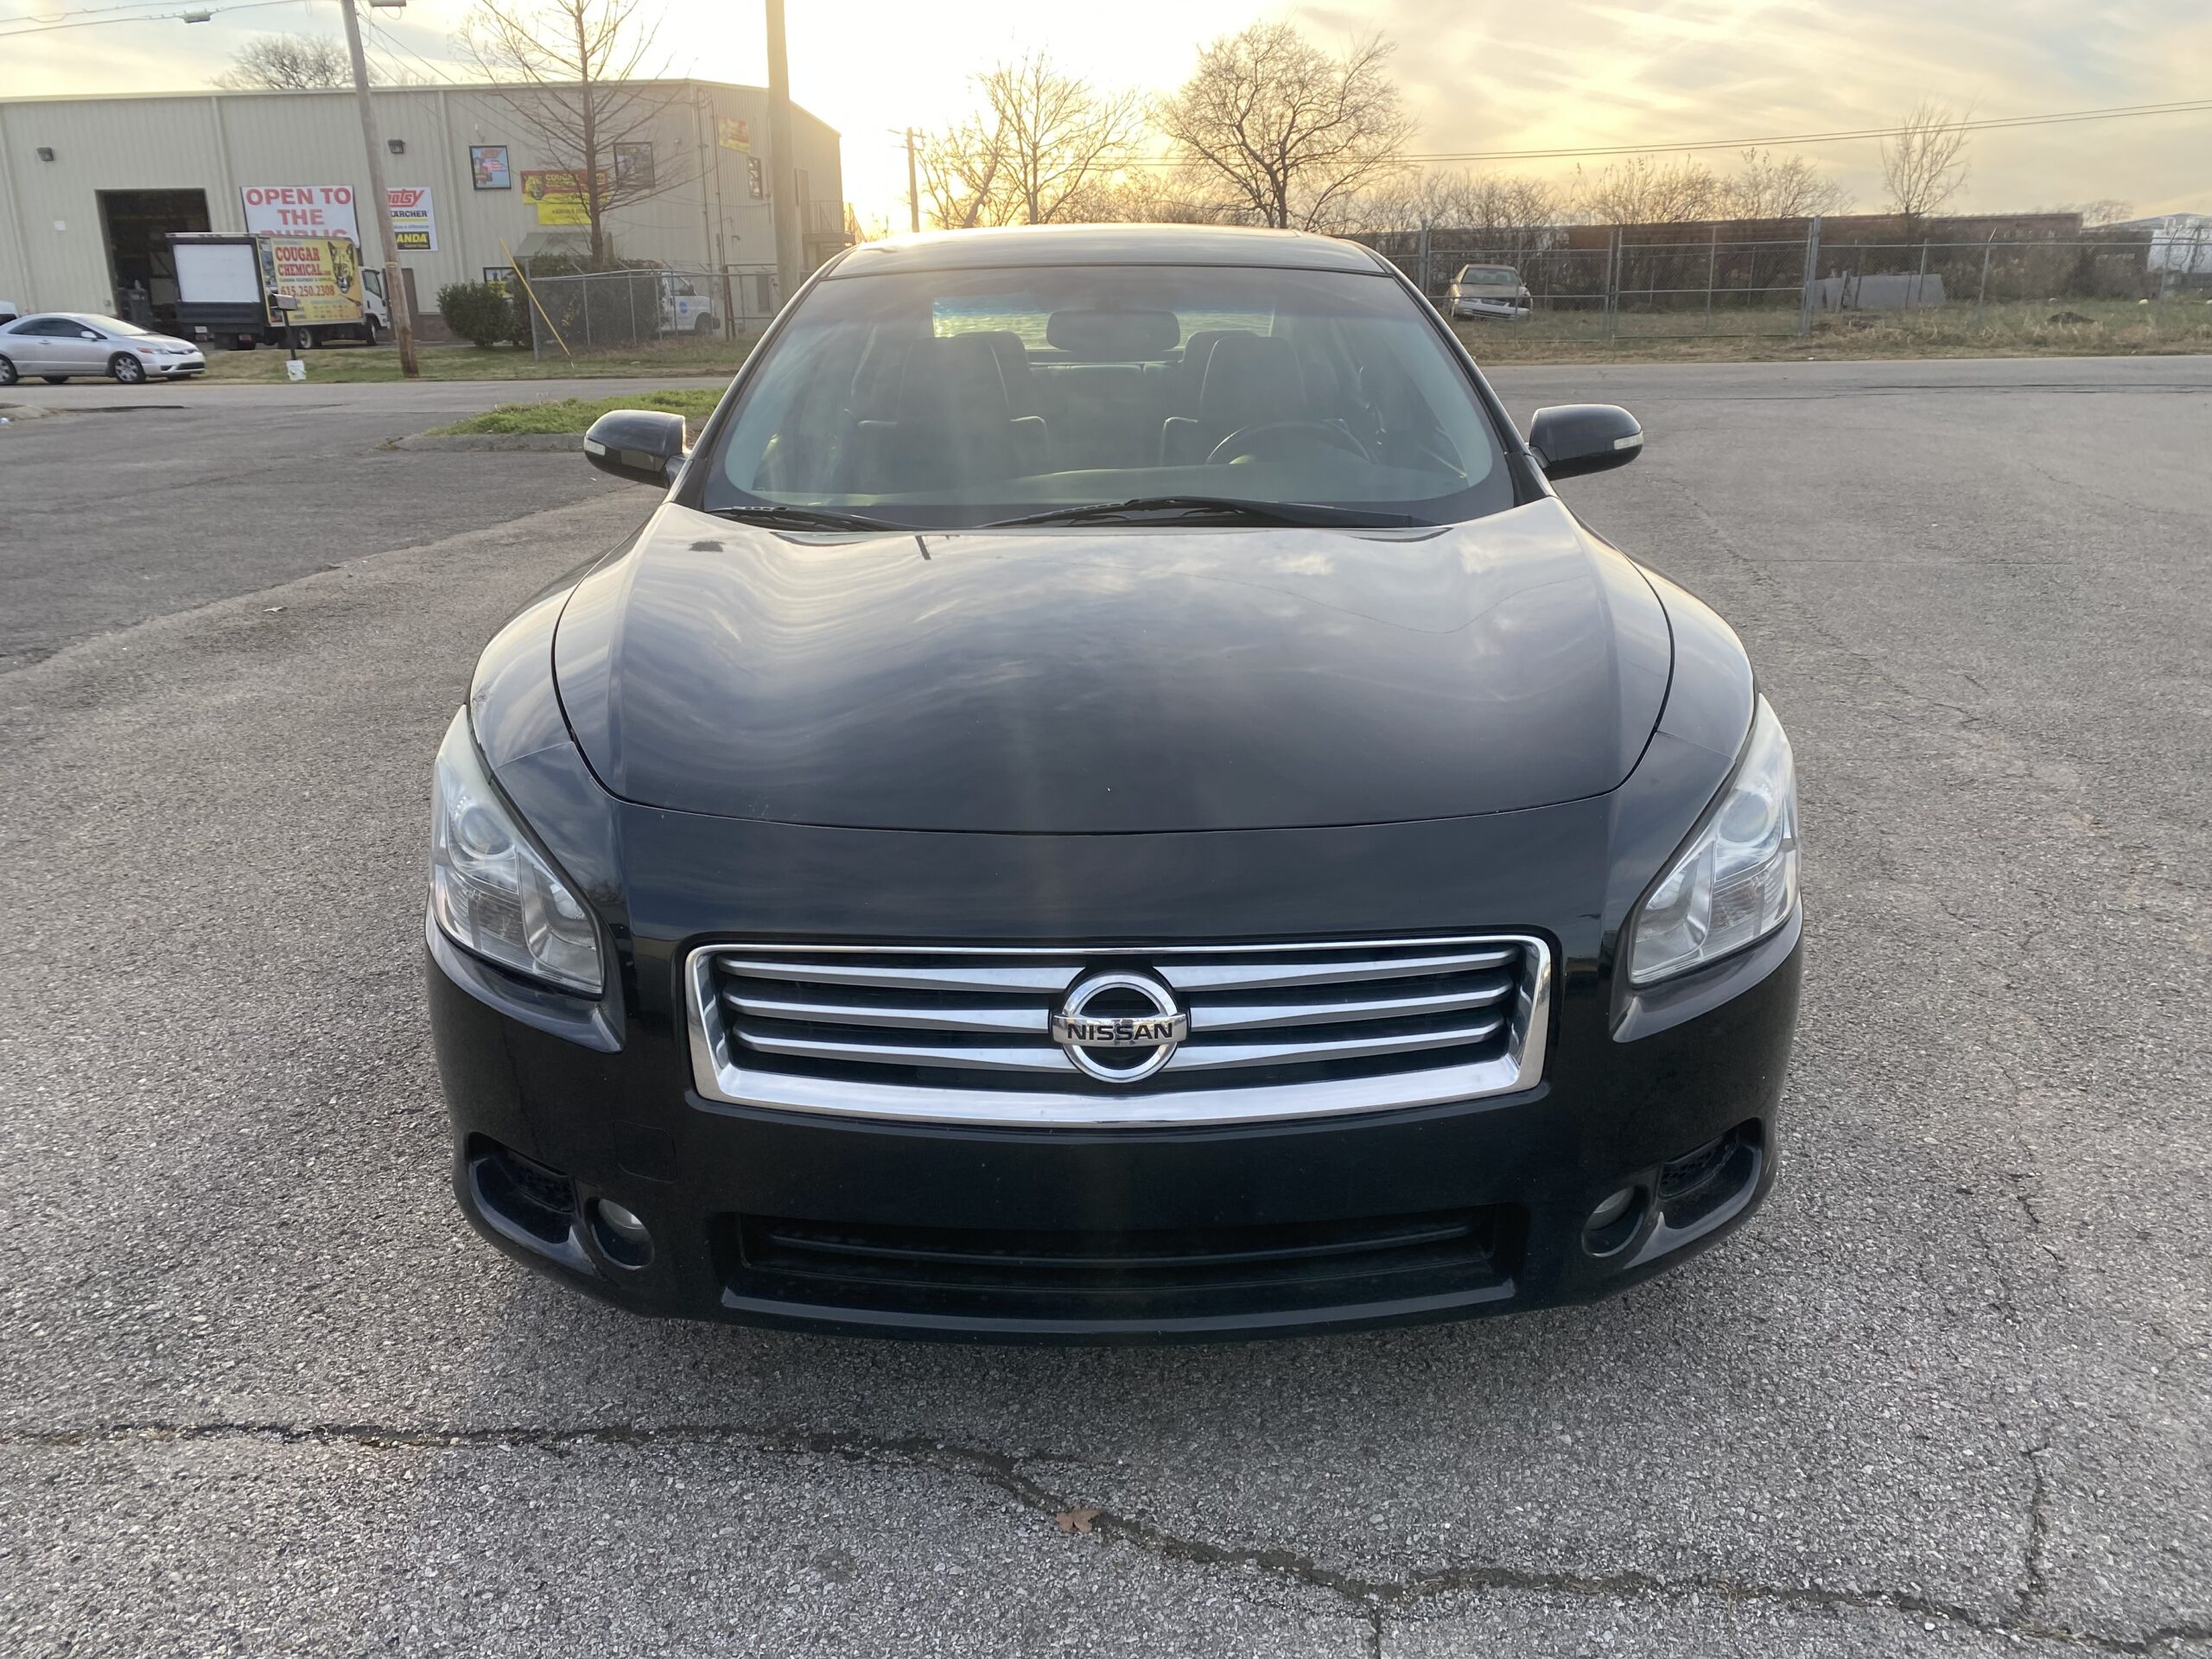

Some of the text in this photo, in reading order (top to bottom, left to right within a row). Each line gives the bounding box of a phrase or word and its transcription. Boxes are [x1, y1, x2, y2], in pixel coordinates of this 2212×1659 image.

[245, 187, 352, 206] OPEN TO
[277, 208, 325, 226] THE
[395, 233, 427, 243] ANDA
[275, 246, 321, 262] COUGAR
[277, 264, 322, 276] CHEMICAL
[280, 284, 335, 297] 615.250.2308
[1067, 1022, 1173, 1041] NISSAN
